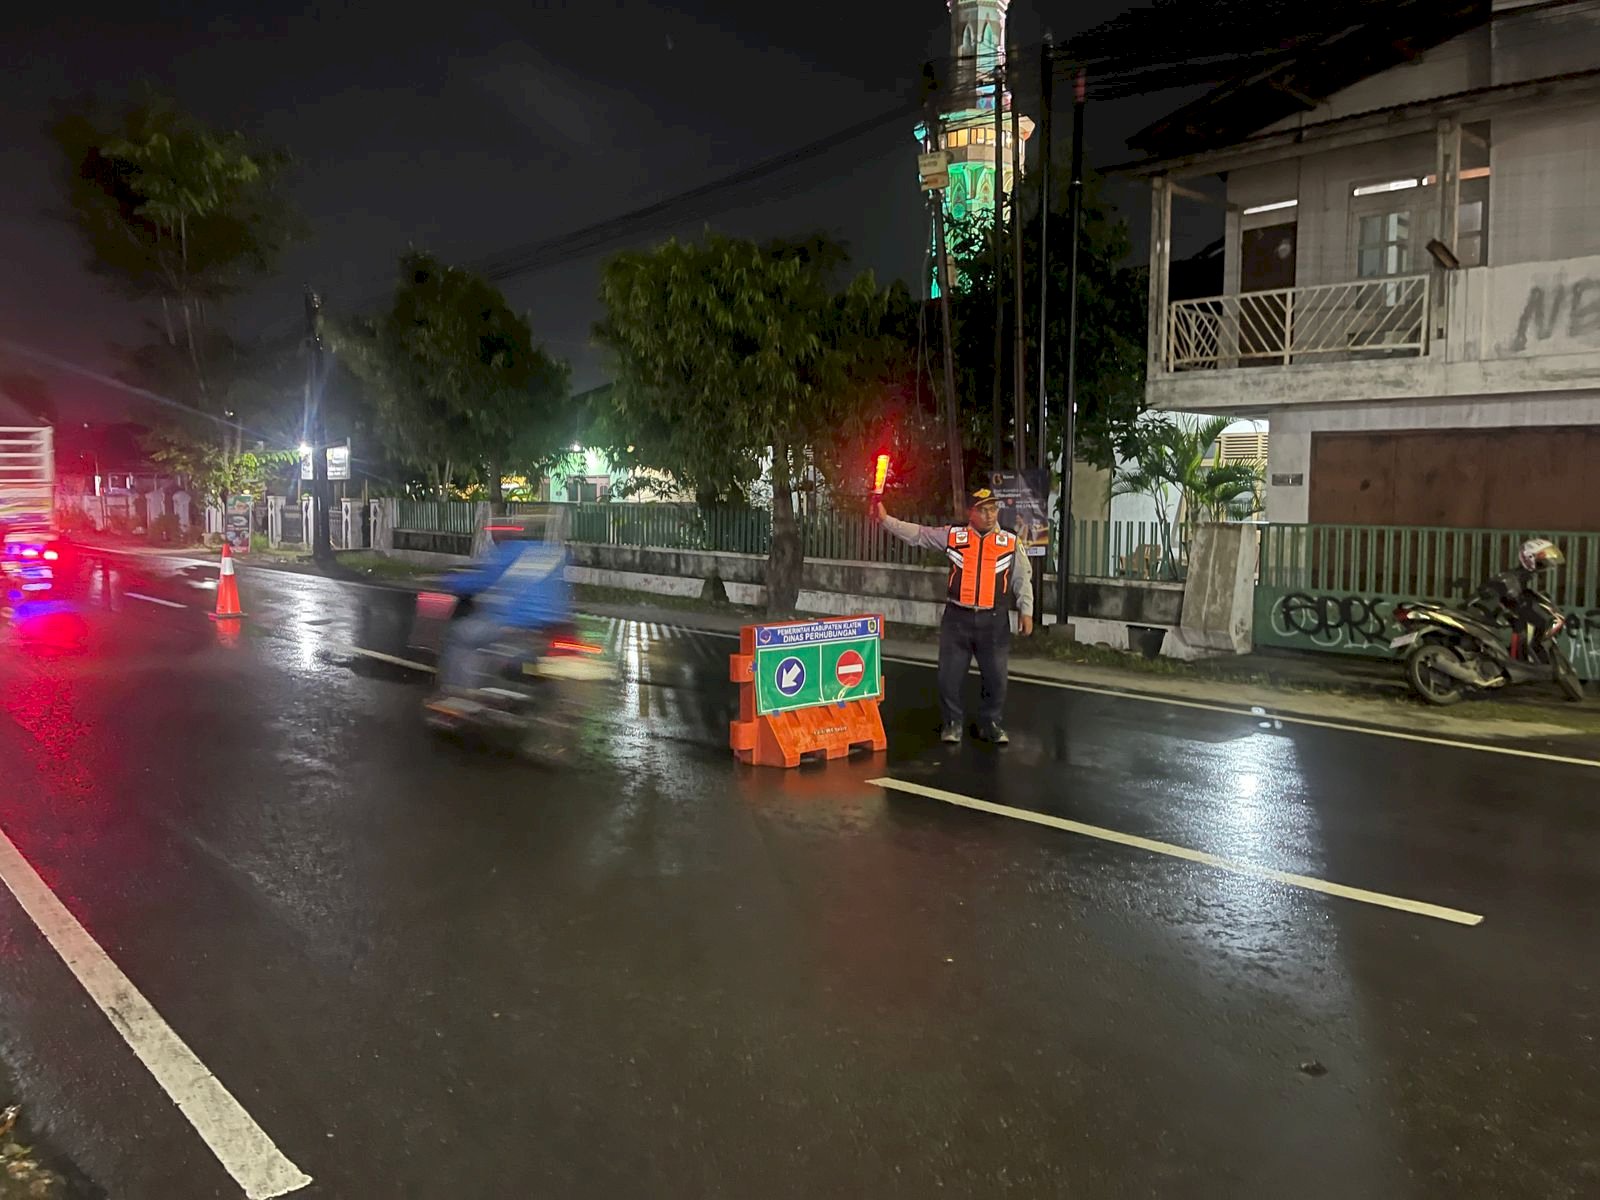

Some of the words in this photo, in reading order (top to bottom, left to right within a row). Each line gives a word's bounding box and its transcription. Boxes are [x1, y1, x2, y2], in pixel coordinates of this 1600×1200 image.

[778, 627, 810, 636] PEMERINTAH
[811, 624, 842, 632] KABUPATEN
[783, 634, 804, 643] DINAS
[805, 629, 856, 640] PERHUBUNGAN
